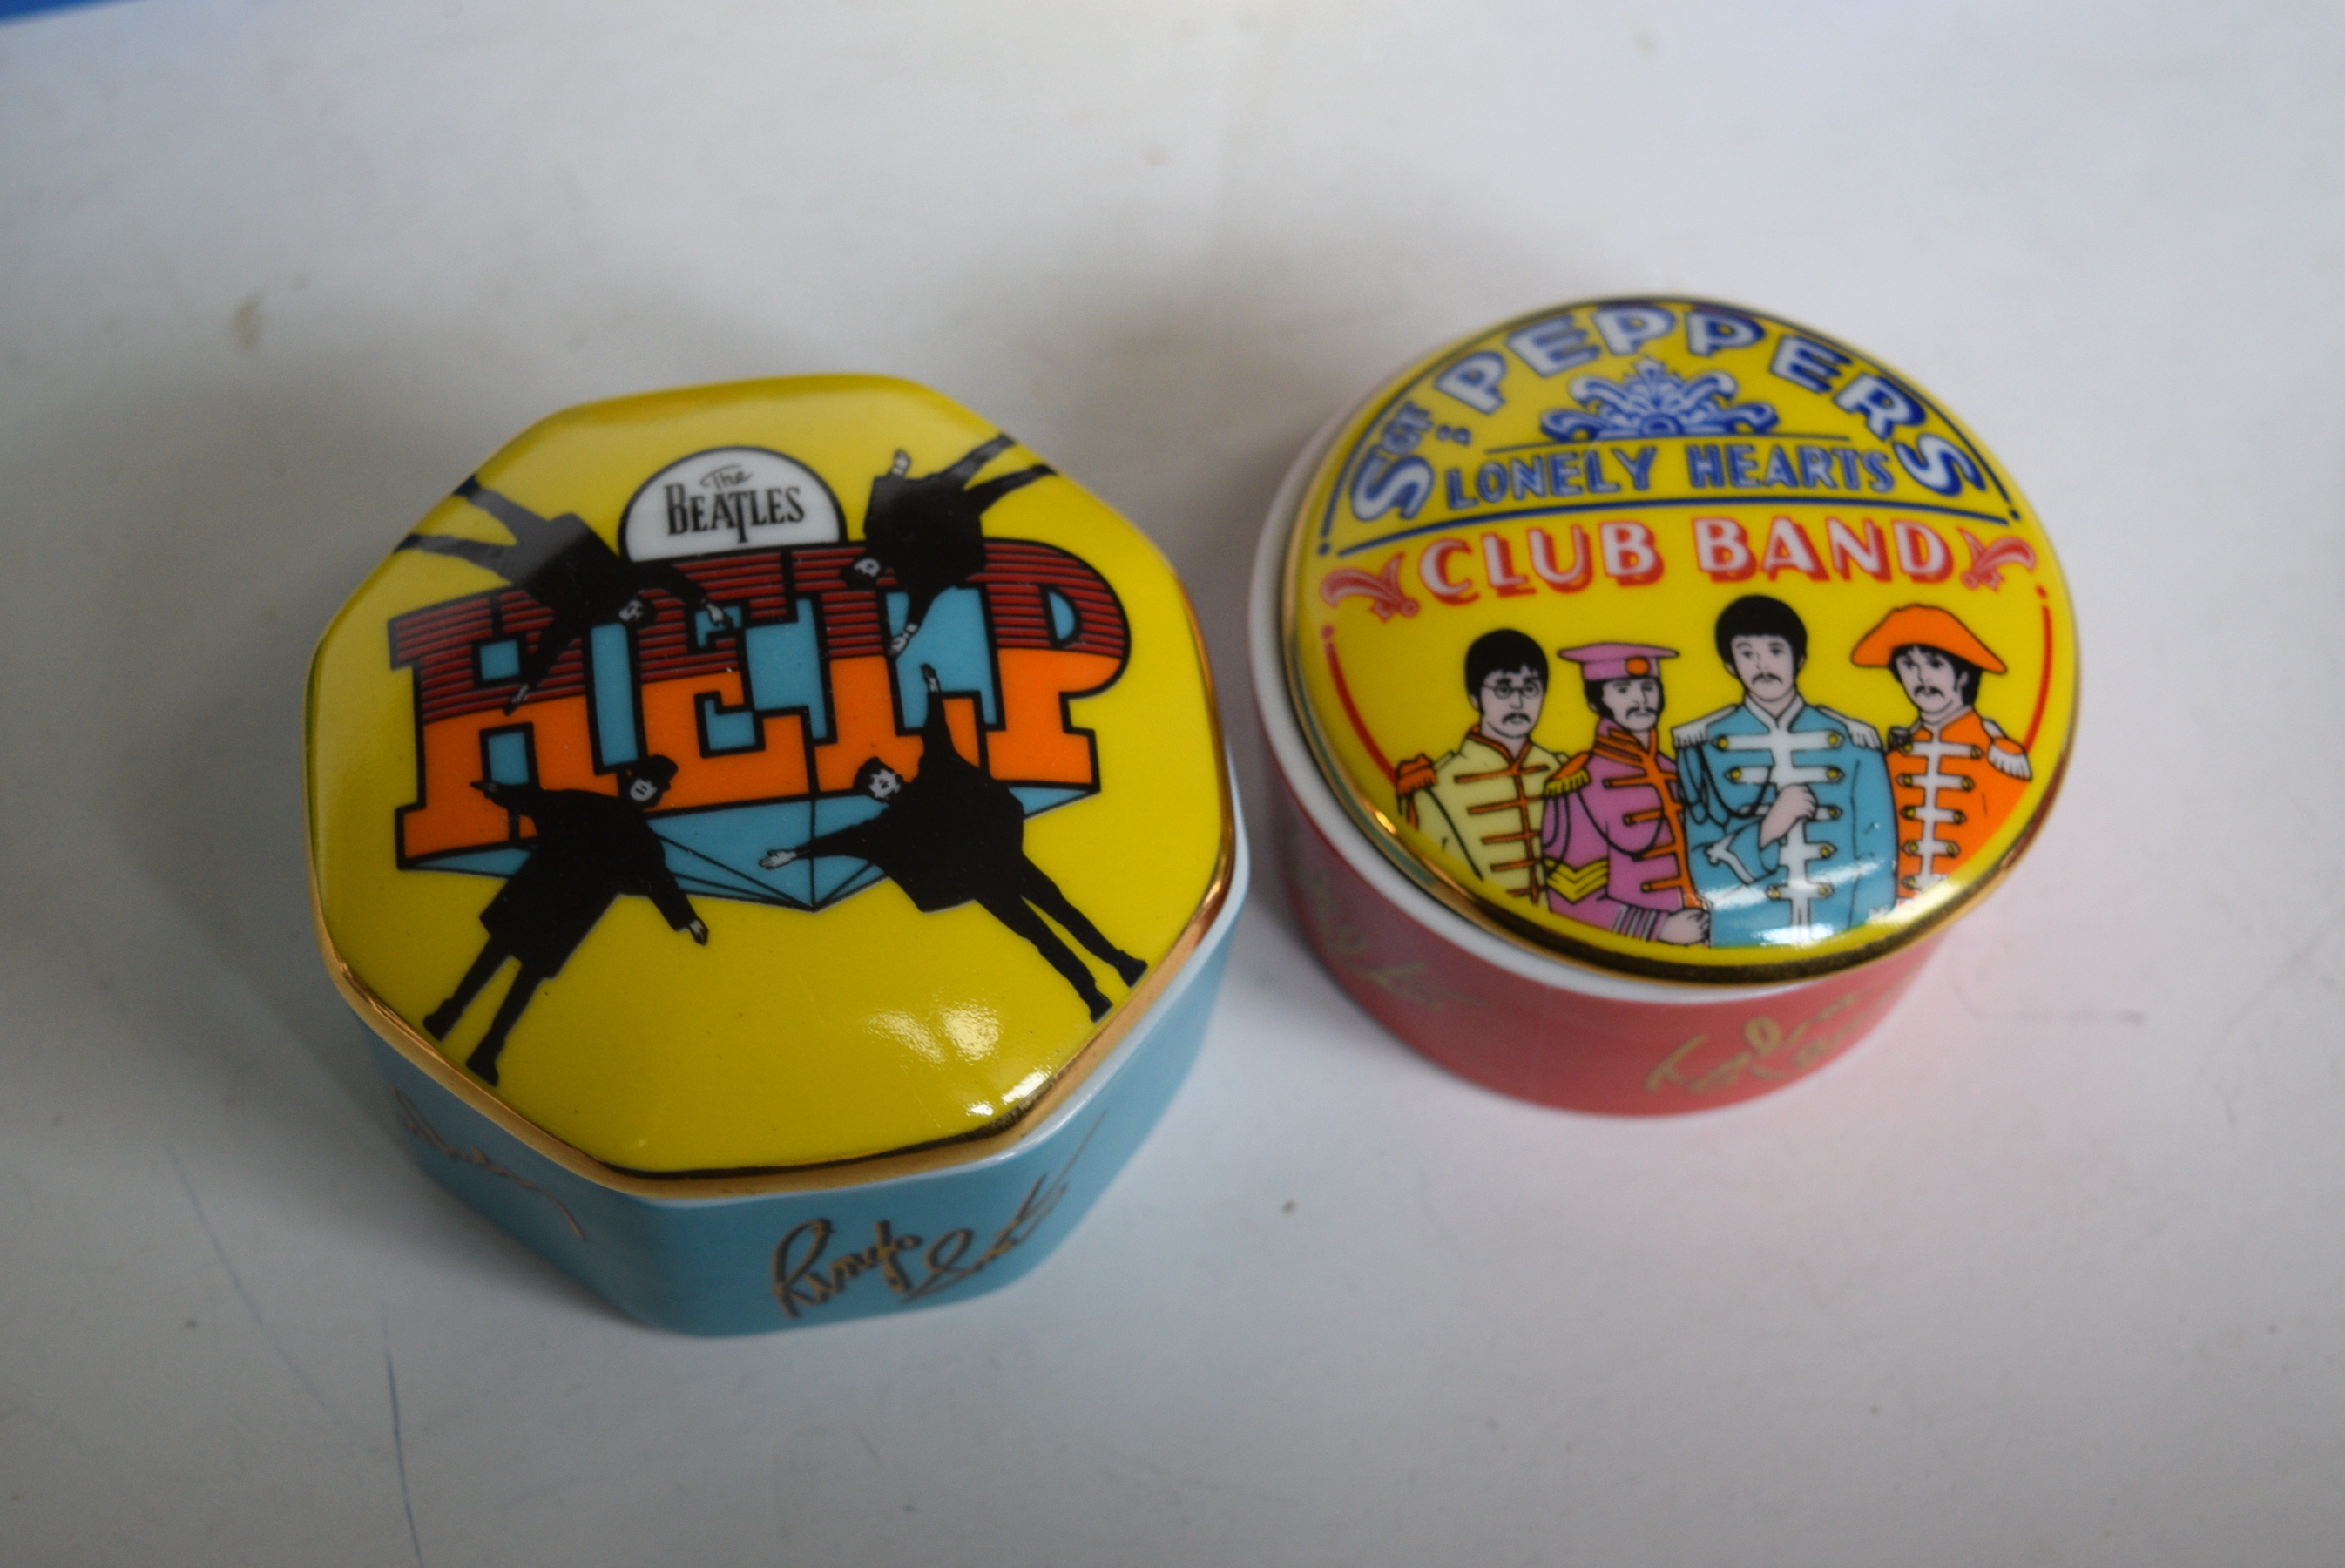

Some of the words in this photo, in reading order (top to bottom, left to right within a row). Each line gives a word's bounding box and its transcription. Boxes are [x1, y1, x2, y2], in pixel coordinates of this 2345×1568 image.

[1435, 301, 1986, 497] PEPPERS
[664, 483, 805, 544] BEATLES
[699, 464, 753, 490] The
[1445, 446, 1657, 510] LONELY
[1689, 440, 1896, 494] HEARTS
[1417, 519, 1666, 606] CLUB
[1693, 516, 1955, 586] BAND
[388, 538, 1132, 871] HELP
